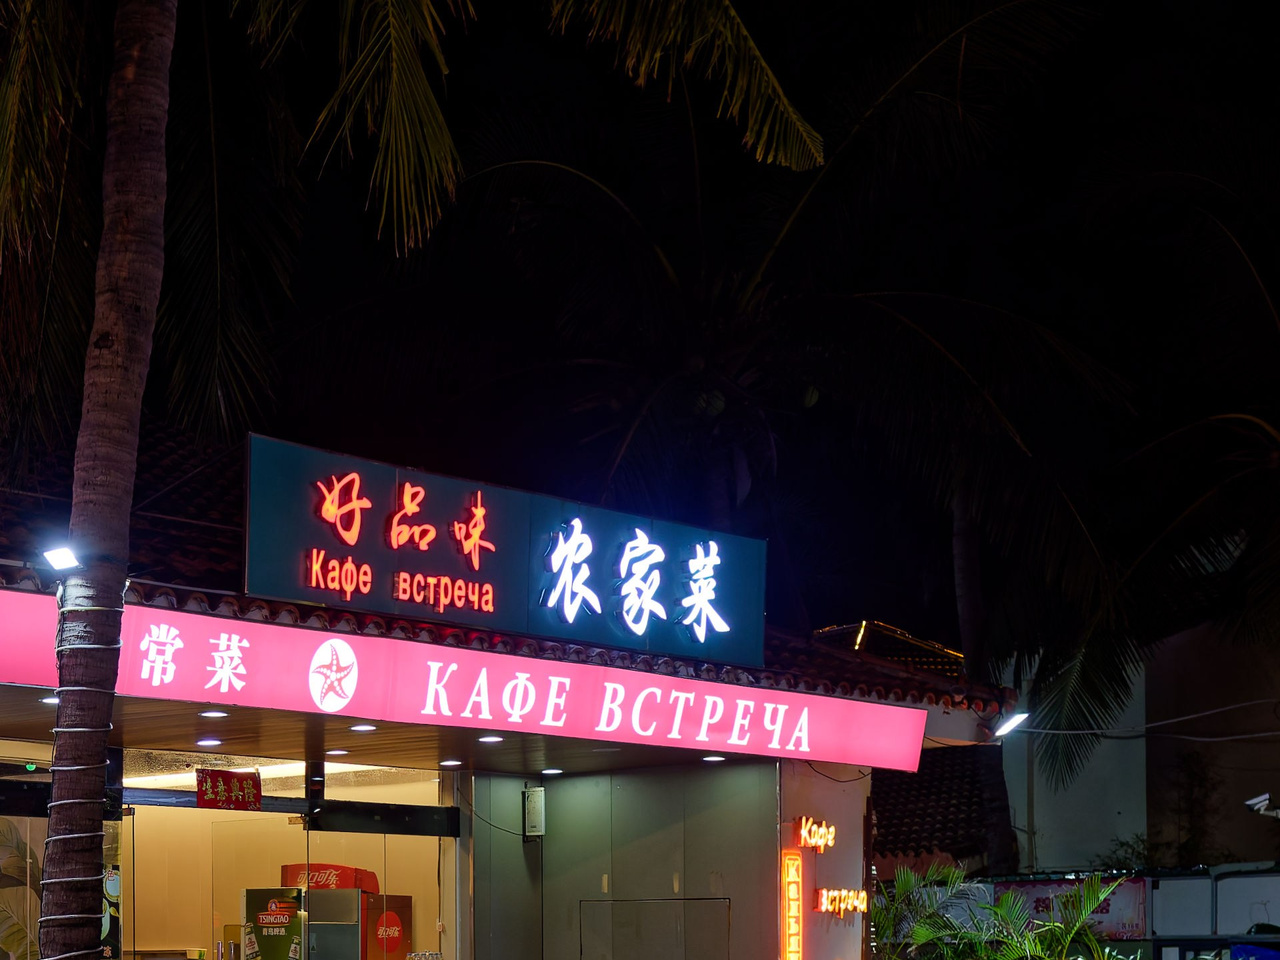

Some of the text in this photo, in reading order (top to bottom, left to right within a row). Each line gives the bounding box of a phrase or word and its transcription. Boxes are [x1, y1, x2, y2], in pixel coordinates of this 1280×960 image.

[317, 472, 496, 571] 好品味
[311, 548, 495, 613] Кафе встреча
[547, 517, 731, 644] 农家菜
[140, 623, 250, 693] 常菜
[421, 661, 811, 753] КАФЕ ВСТРЕЧА
[258, 914, 289, 924] TSINGTAO
